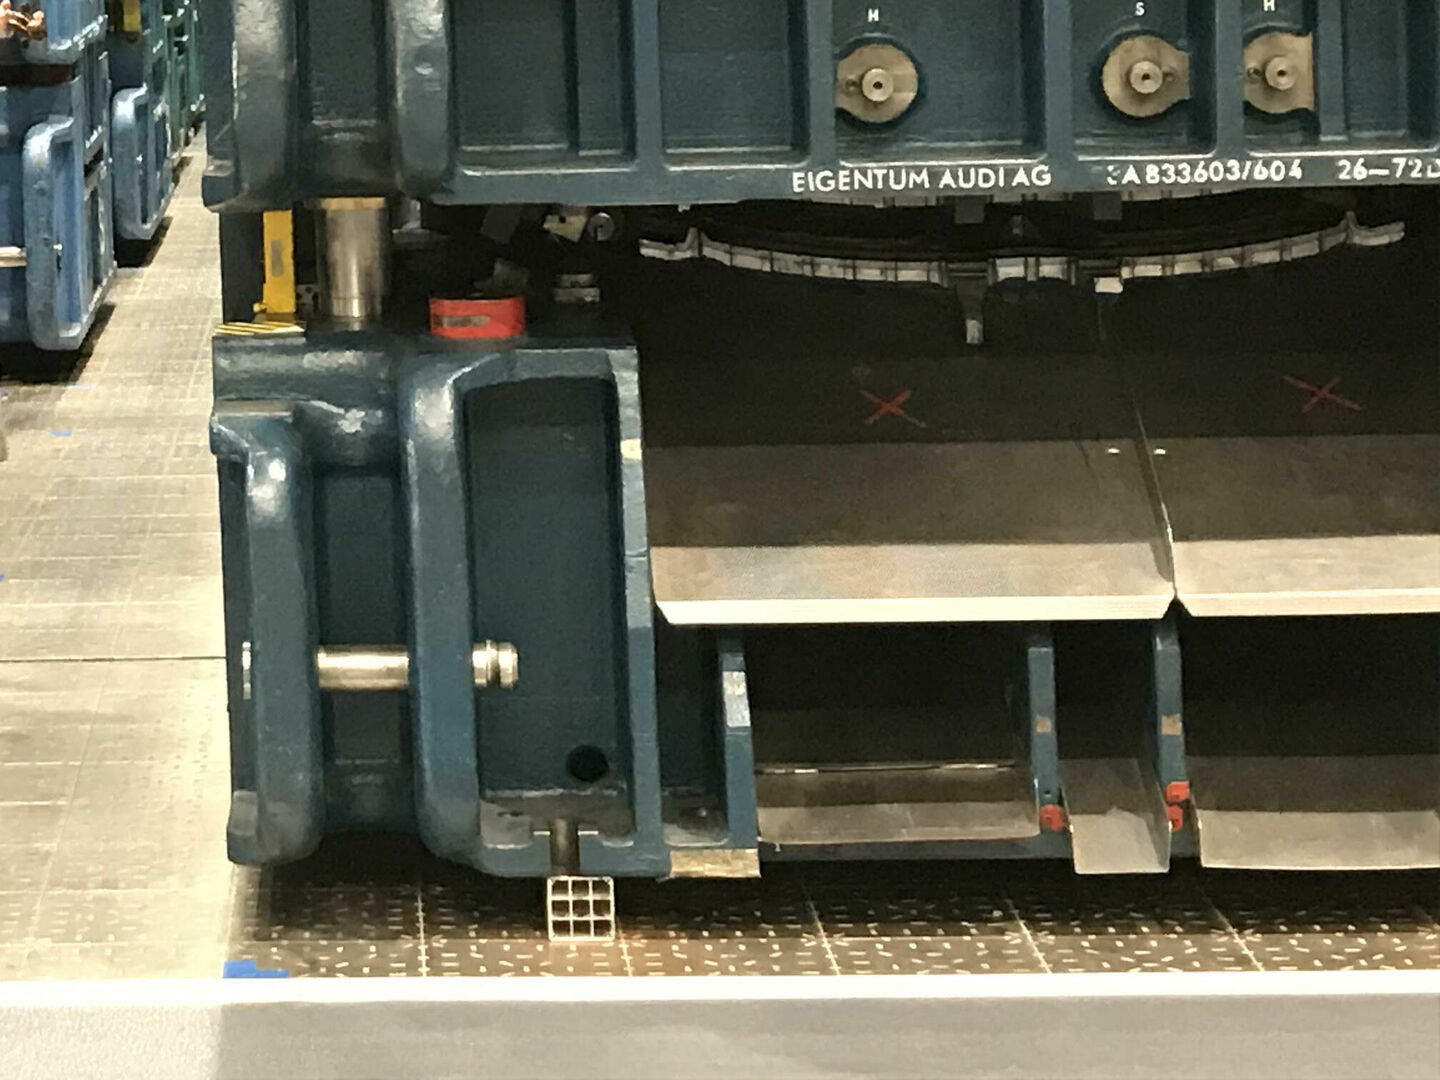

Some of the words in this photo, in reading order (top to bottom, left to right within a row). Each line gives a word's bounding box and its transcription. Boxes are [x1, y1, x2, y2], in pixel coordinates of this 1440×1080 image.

[868, 9, 879, 23] H
[1135, 2, 1145, 17] S
[792, 167, 930, 193] EIGENTUM
[938, 167, 1004, 190] AUDI
[1011, 165, 1051, 186] AG
